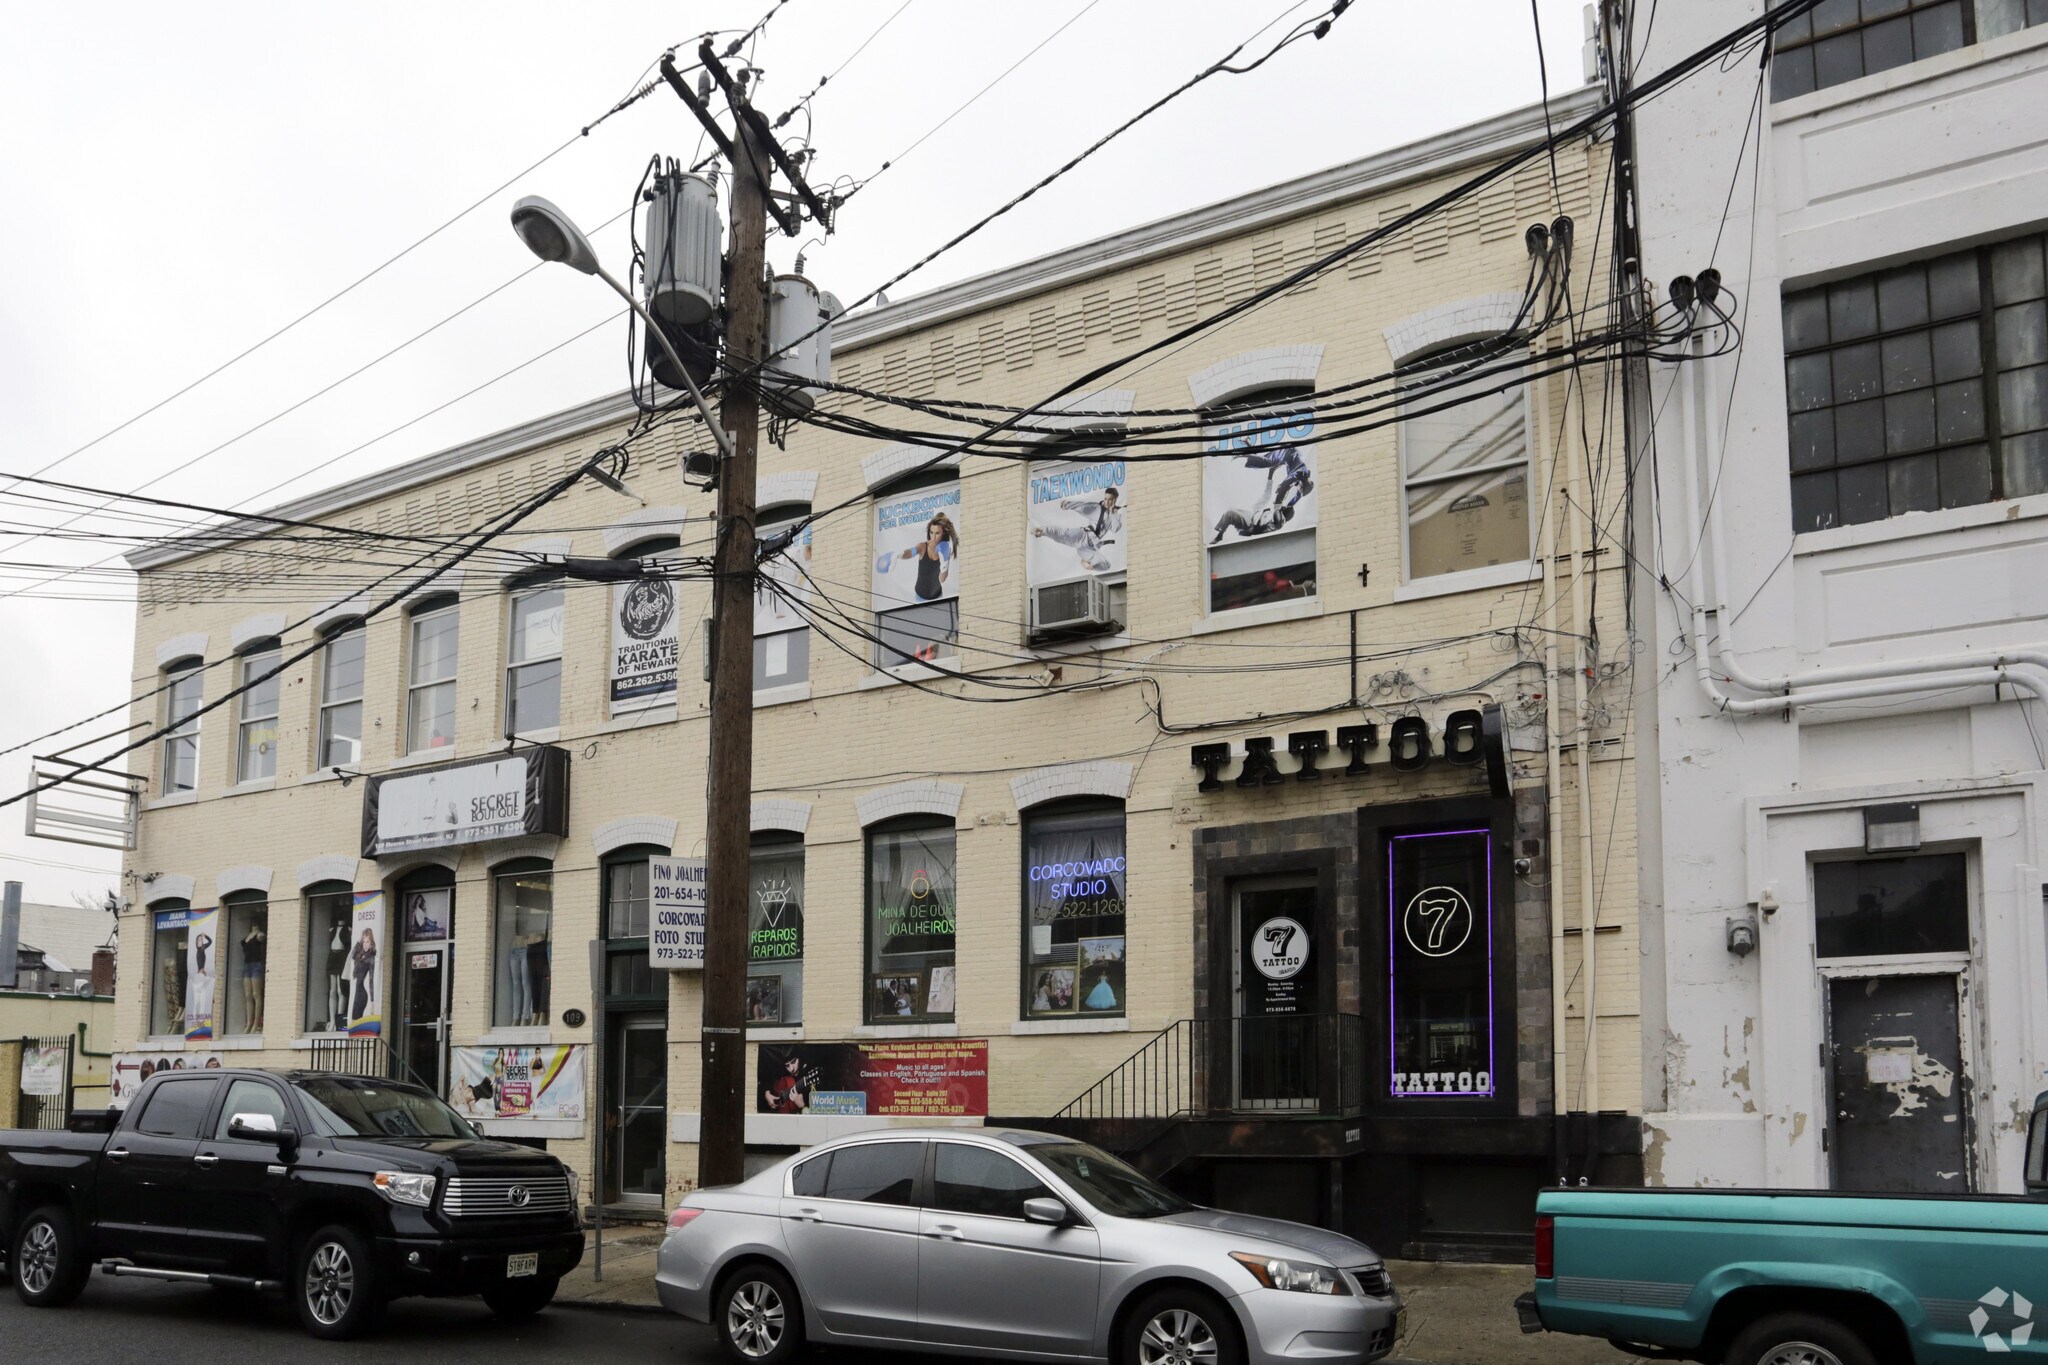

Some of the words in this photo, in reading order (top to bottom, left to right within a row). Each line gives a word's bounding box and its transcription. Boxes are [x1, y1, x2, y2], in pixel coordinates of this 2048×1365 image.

[1208, 413, 1314, 452] JUDO
[1031, 460, 1125, 504] TAEKWONDO
[879, 490, 960, 520] KICKBOXING
[879, 518, 897, 531] FOR
[899, 511, 934, 526] WOMEN
[619, 637, 678, 654] TRADITIONAL
[618, 644, 678, 666] KARATE
[618, 665, 630, 675] OF
[634, 656, 678, 672] NEWARK
[1191, 709, 1485, 792] TATTOO
[471, 791, 519, 812] SECRET
[654, 865, 671, 880] FINO
[1030, 856, 1125, 880] CORCOVADO
[1051, 879, 1107, 899] STUDIO
[169, 912, 186, 920] JEANS
[358, 911, 375, 921] DRESS
[878, 906, 905, 919] MINA
[910, 905, 926, 917] DE
[885, 920, 955, 935] JOALHEIROS
[1420, 898, 1457, 948] 7
[655, 930, 679, 944] FOTO
[751, 928, 797, 943] REPAROS
[1264, 925, 1296, 957] 7
[753, 943, 797, 958] RAPIDOS
[1263, 957, 1299, 966] TATTOO
[566, 1012, 580, 1023] 109
[506, 1066, 528, 1075] SECRET
[914, 1070, 947, 1078] Portuguese
[930, 1063, 946, 1071] ages!
[1393, 1071, 1490, 1092] TATTOO
[811, 1095, 835, 1104] World
[836, 1095, 859, 1104] Music
[811, 1105, 838, 1114] School
[840, 1106, 846, 1114] &
[848, 1105, 863, 1114] Arts
